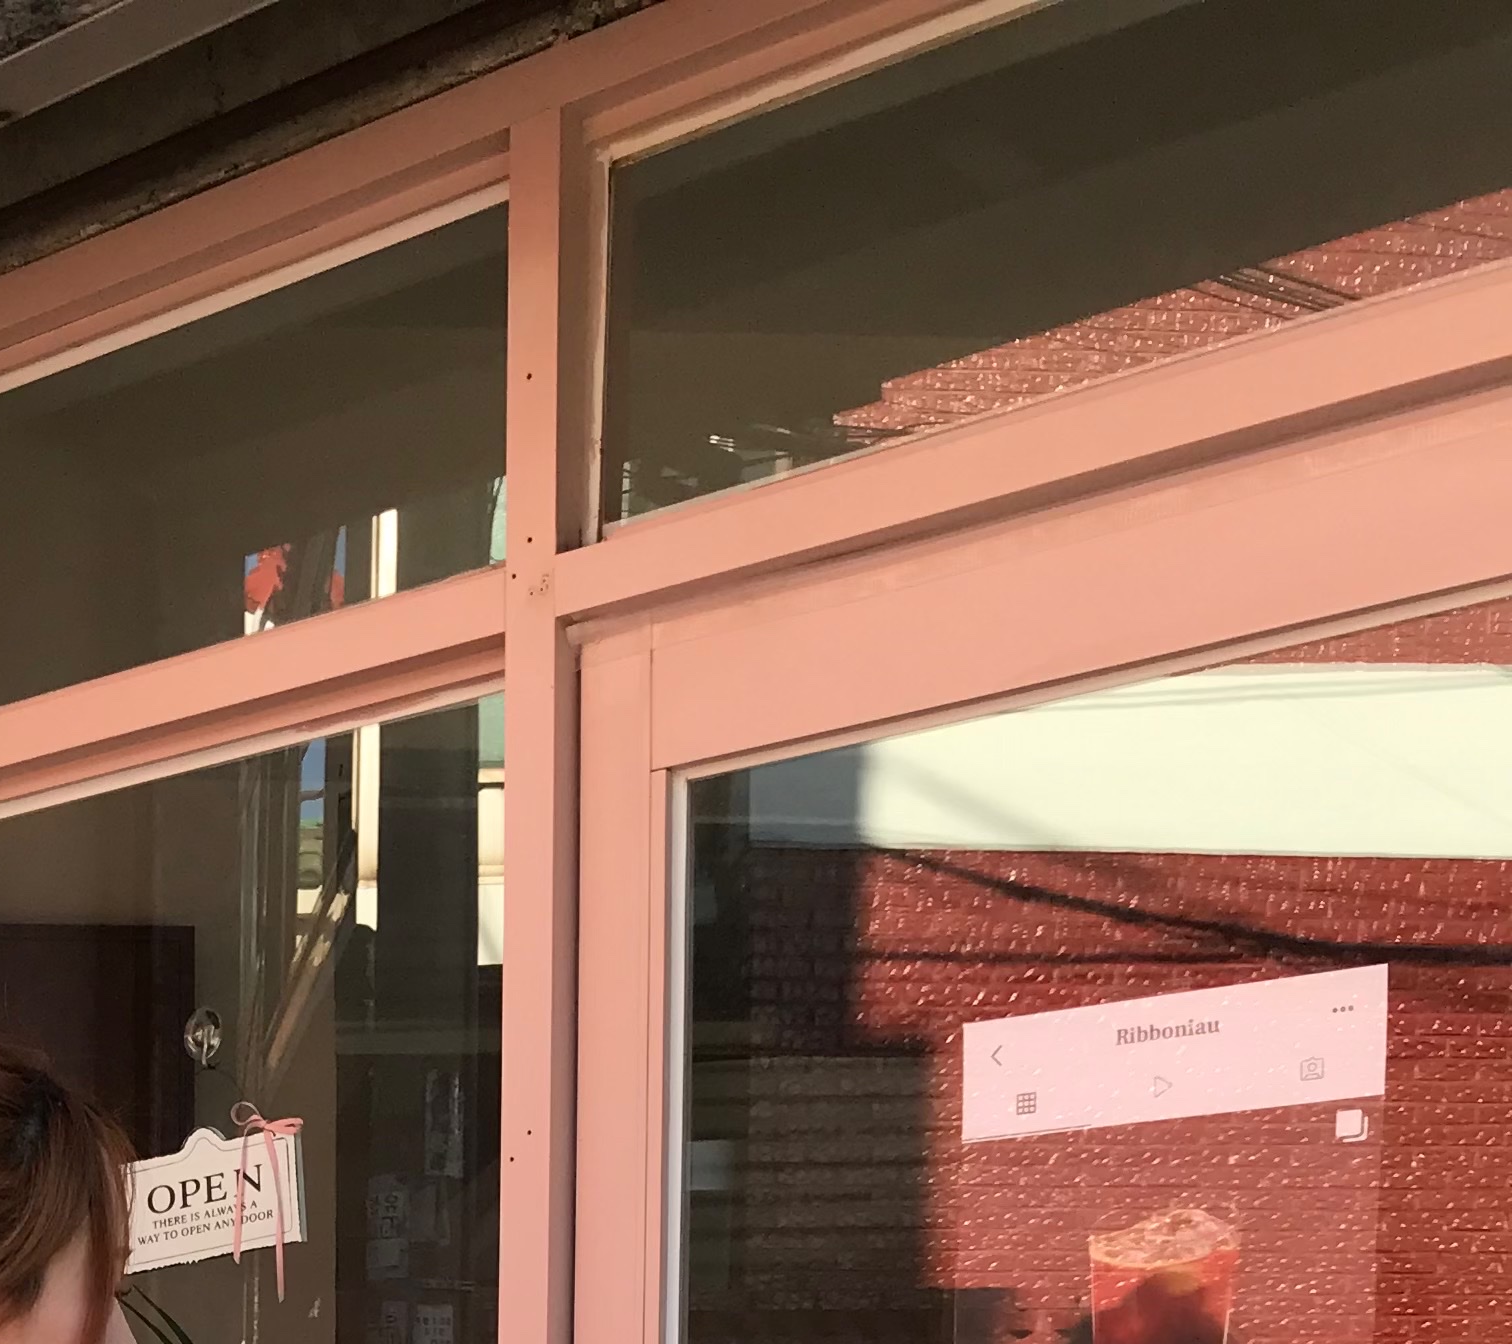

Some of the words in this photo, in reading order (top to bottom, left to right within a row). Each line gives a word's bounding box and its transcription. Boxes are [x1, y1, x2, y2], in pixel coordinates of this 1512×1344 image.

[1116, 1019, 1220, 1045] Ribboniau
[147, 1164, 262, 1214] OPEN
[137, 1234, 160, 1246] WAY
[163, 1230, 178, 1241] TO
[181, 1223, 210, 1237] OPEN
[241, 1209, 274, 1225] DOOR
[152, 1215, 187, 1229] THERE
[190, 1211, 201, 1222] IS
[250, 1200, 257, 1209] A
